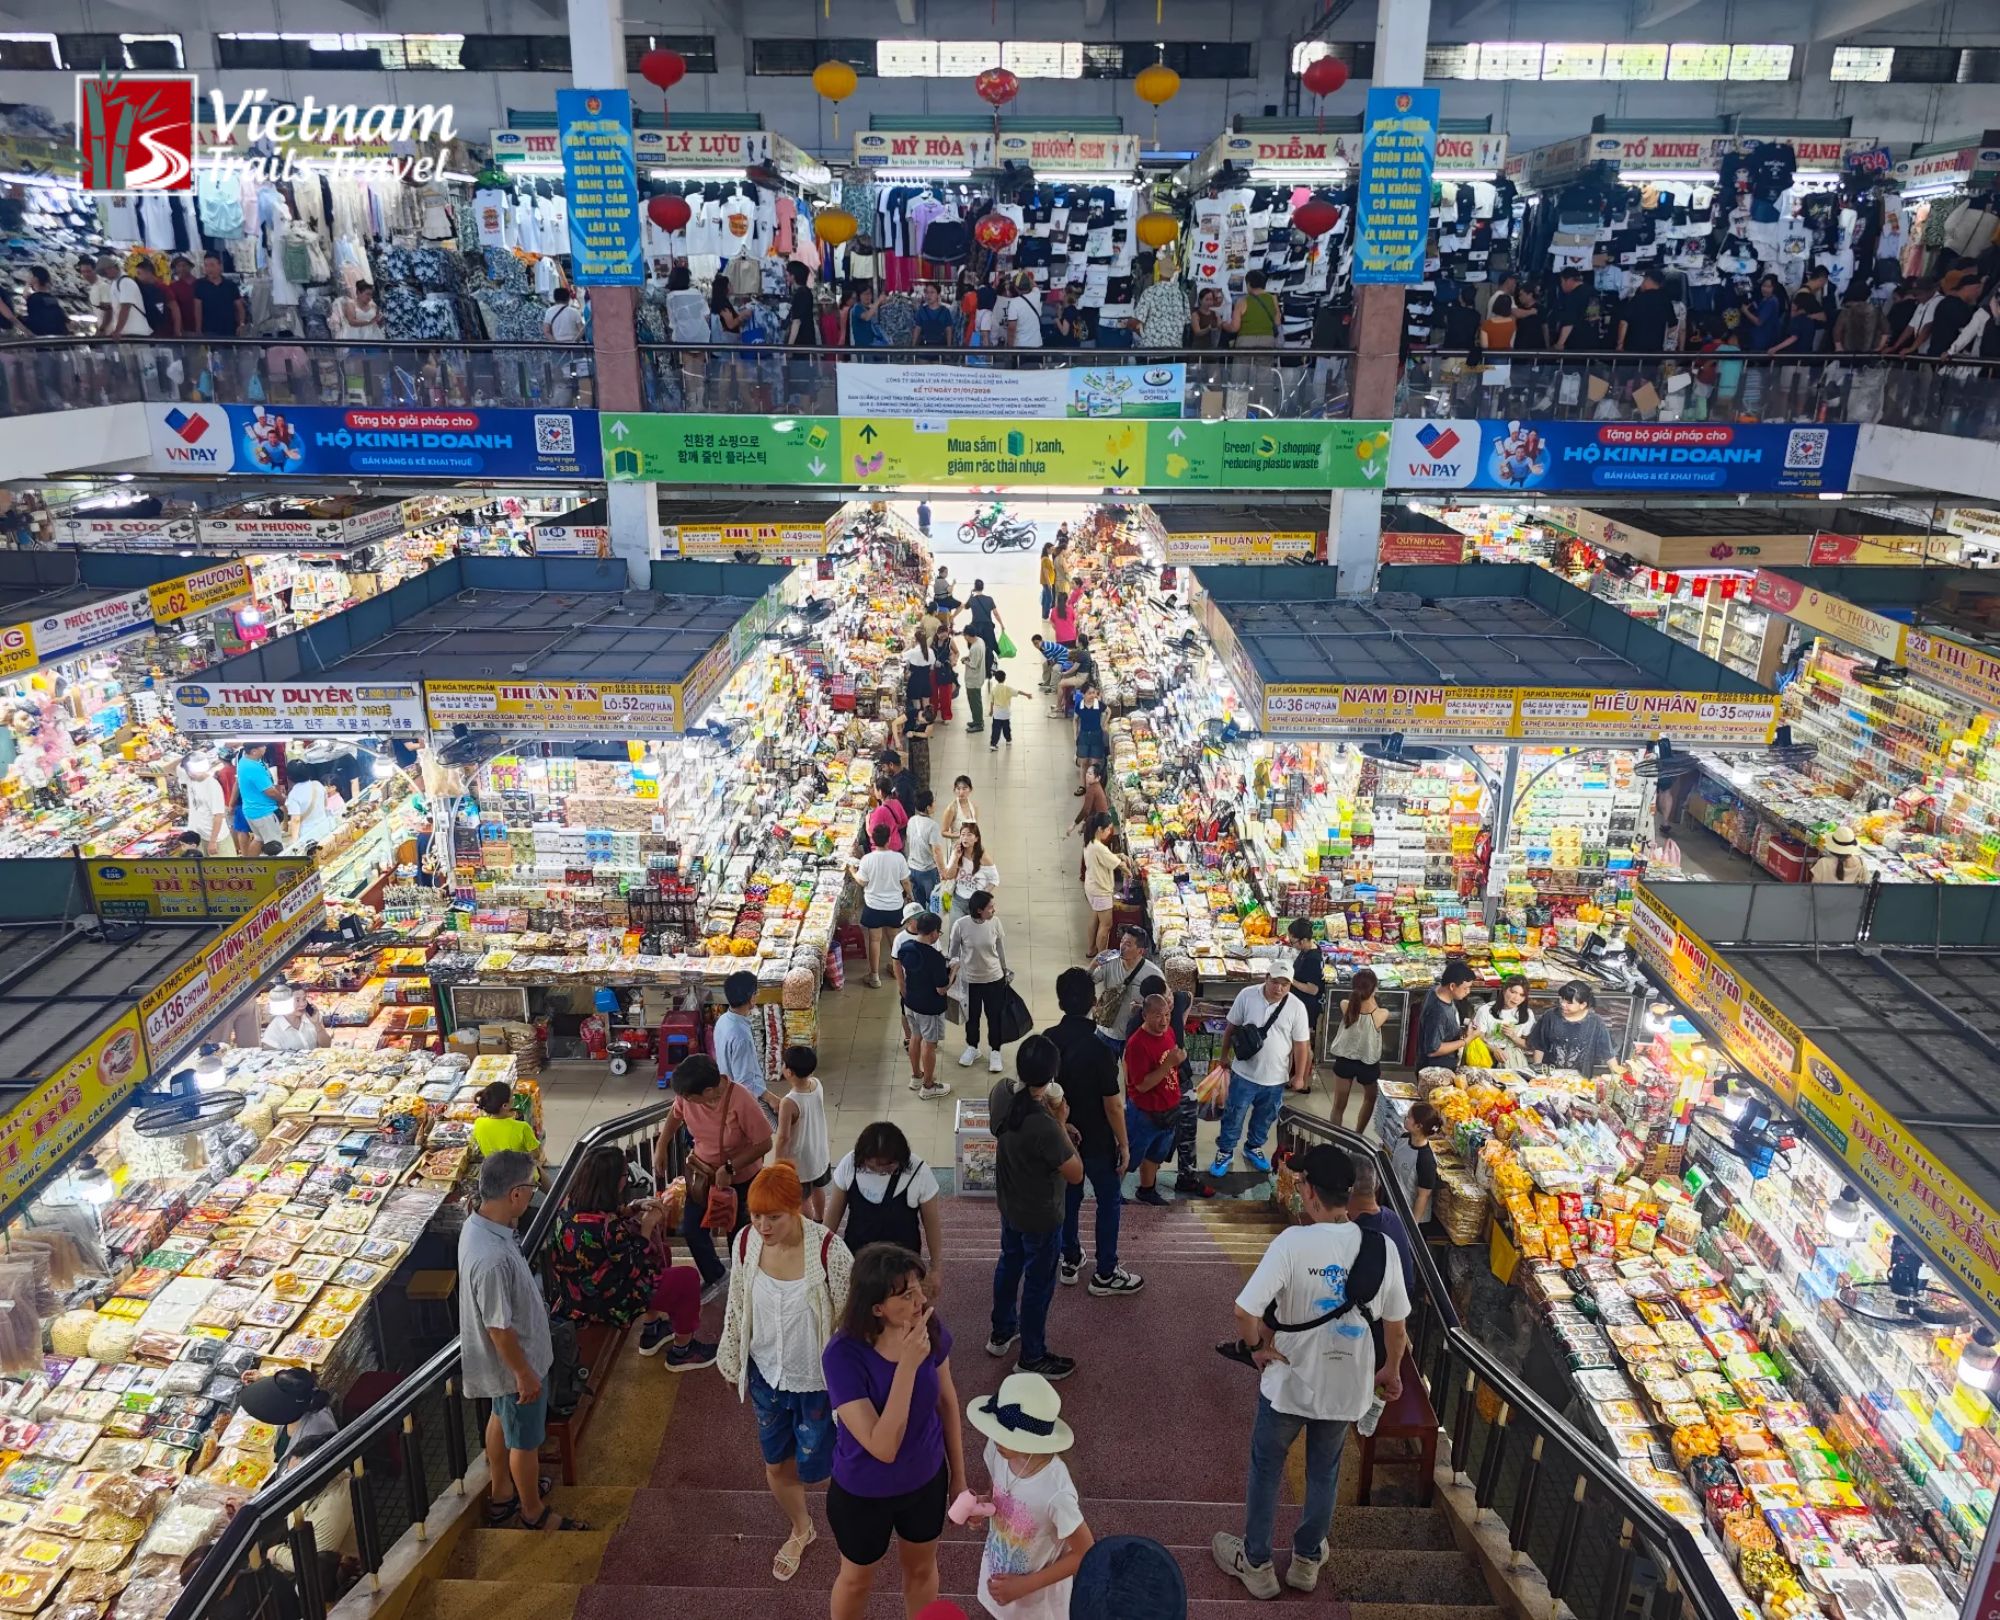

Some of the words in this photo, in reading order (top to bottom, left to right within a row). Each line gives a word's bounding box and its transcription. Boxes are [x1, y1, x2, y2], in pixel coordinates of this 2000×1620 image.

[666, 132, 693, 152] LÝ
[892, 136, 920, 156] MỸ
[925, 137, 964, 156] HÒA
[1652, 144, 1699, 157] MINH
[353, 414, 377, 429] Tặng
[379, 414, 396, 428] bộ
[397, 415, 418, 430] giải
[419, 414, 445, 430] pháp
[447, 416, 473, 427] cho
[316, 428, 352, 450] HỘ
[355, 432, 419, 449] KINH
[422, 433, 513, 449] DOANH
[683, 433, 715, 448] 친환경
[717, 433, 761, 448] 쇼핑으로
[947, 438, 971, 453] Mua
[974, 434, 997, 453] sắm
[1035, 438, 1065, 455] xanh,
[1605, 428, 1632, 443] Tặng
[1634, 428, 1651, 442] bộ
[1652, 429, 1672, 444] giải
[1674, 429, 1701, 444] pháp
[1703, 430, 1728, 441] cho
[165, 447, 218, 462] VNPAY
[362, 454, 383, 467] BÁN
[384, 455, 411, 467] HÀNG
[431, 456, 449, 467] KHAI
[677, 449, 699, 465] 함께
[725, 449, 767, 465] 플라스틱
[1563, 443, 1599, 464] HỘ
[1603, 447, 1668, 463] KINH
[1671, 447, 1762, 463] DOANH
[947, 457, 978, 476] giảm
[980, 458, 995, 473] rác
[996, 458, 1017, 473] thải
[1019, 459, 1046, 476] nhựa
[1223, 458, 1262, 472] reducing
[1262, 458, 1291, 472] plastic
[1292, 459, 1319, 470] waste
[1408, 463, 1462, 477] VNPAY
[1604, 470, 1624, 482] BÁN
[1625, 471, 1648, 482] HÀNG
[1669, 471, 1690, 482] KHAI
[235, 522, 260, 532] KIM
[1428, 537, 1446, 547] NGA
[188, 563, 244, 594] PHƯƠNG
[190, 585, 224, 604] SOUVENIR
[229, 577, 247, 592] TOYS
[168, 592, 188, 615] 62
[1935, 641, 1972, 669] THU
[218, 684, 275, 703] THÙY
[283, 684, 353, 704] DUYÊN
[1343, 688, 1387, 704] NAM
[1393, 688, 1443, 708] ĐỊNH
[1643, 692, 1698, 713] NHÂN
[656, 701, 673, 712] HÀN
[219, 719, 254, 730] 纪念品
[263, 719, 294, 729] 工艺品
[134, 865, 161, 876] GIA
[1677, 931, 1709, 973] THANH
[1847, 1091, 1876, 1126] GIA
